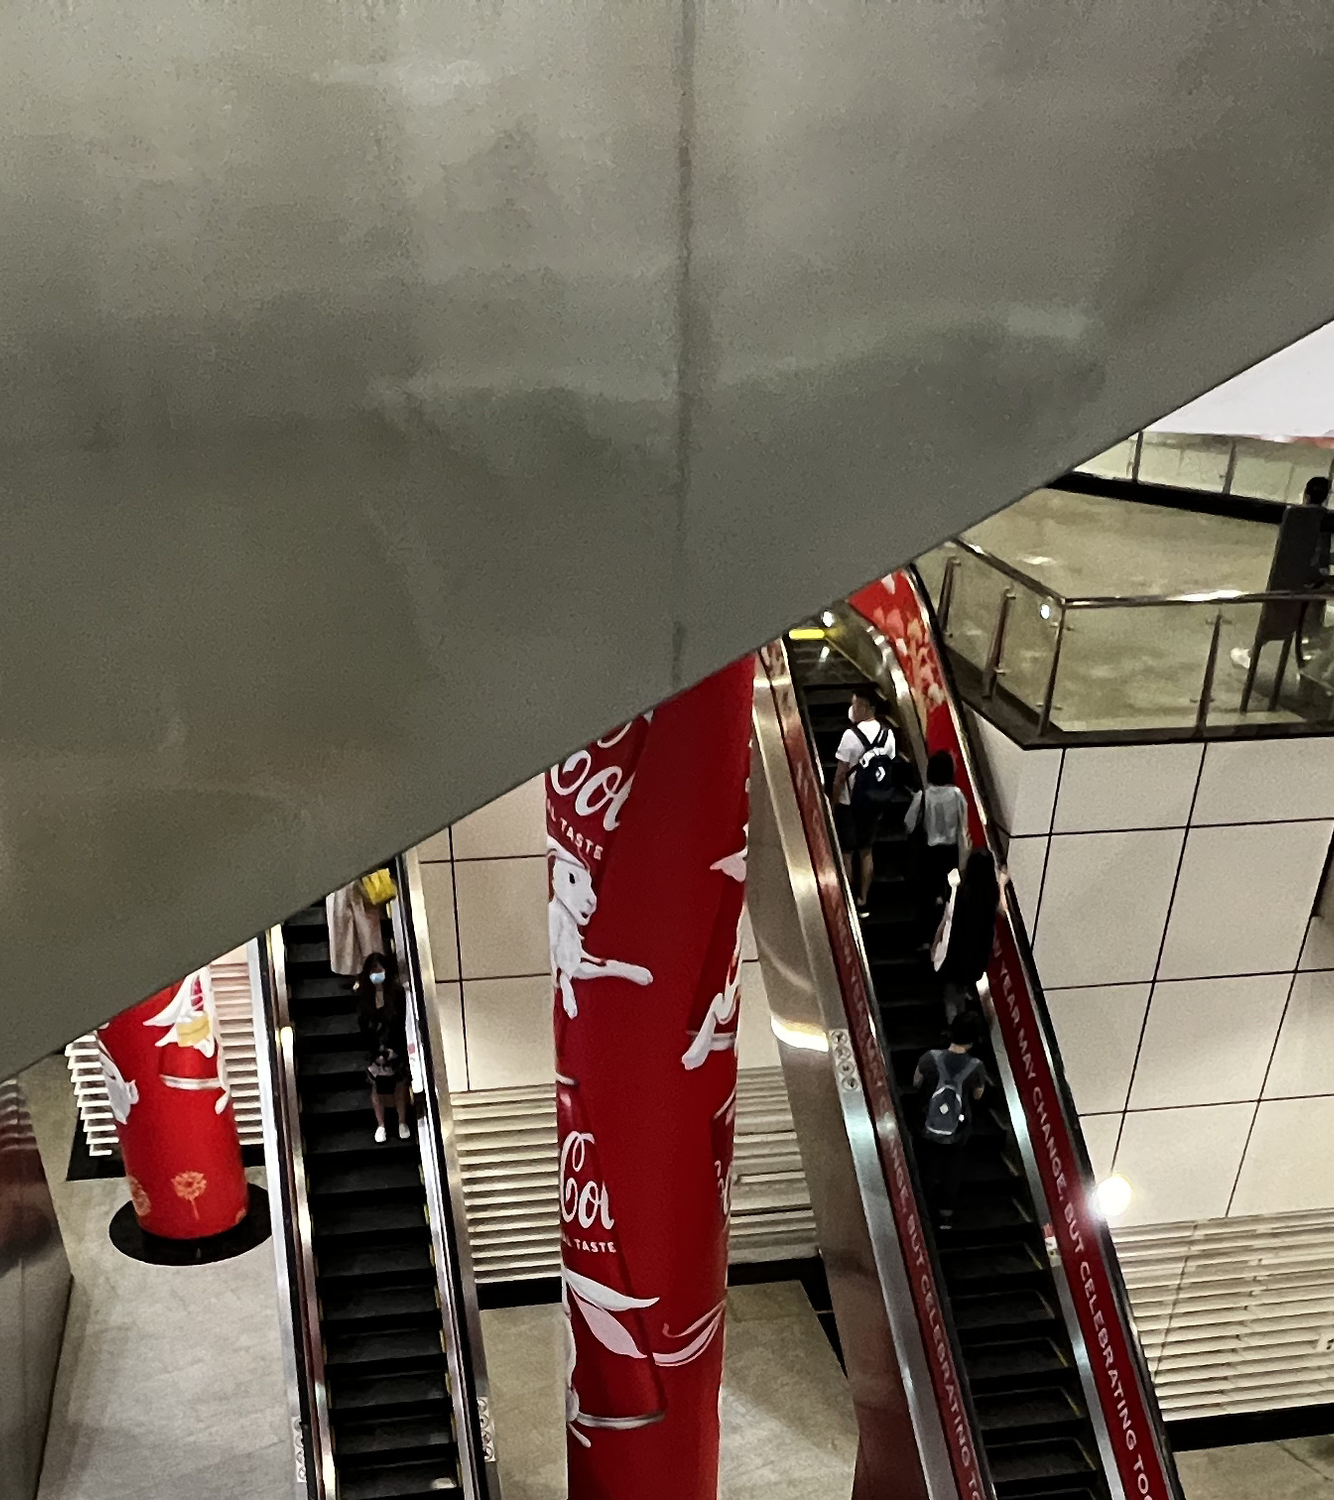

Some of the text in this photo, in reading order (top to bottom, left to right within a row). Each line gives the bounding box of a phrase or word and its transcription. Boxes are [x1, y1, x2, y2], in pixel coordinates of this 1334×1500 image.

[560, 817, 604, 861] TASTE
[574, 1238, 617, 1253] TASTE
[1000, 959, 1021, 1028] YEAR
[1017, 1028, 1037, 1080] MAY
[1031, 1086, 1065, 1203] CHANGE,
[1064, 1203, 1085, 1254] BUT
[1079, 1261, 1137, 1451] CELEBRATING
[907, 1214, 924, 1266] BUT
[921, 1275, 971, 1468] CELEBRATING
